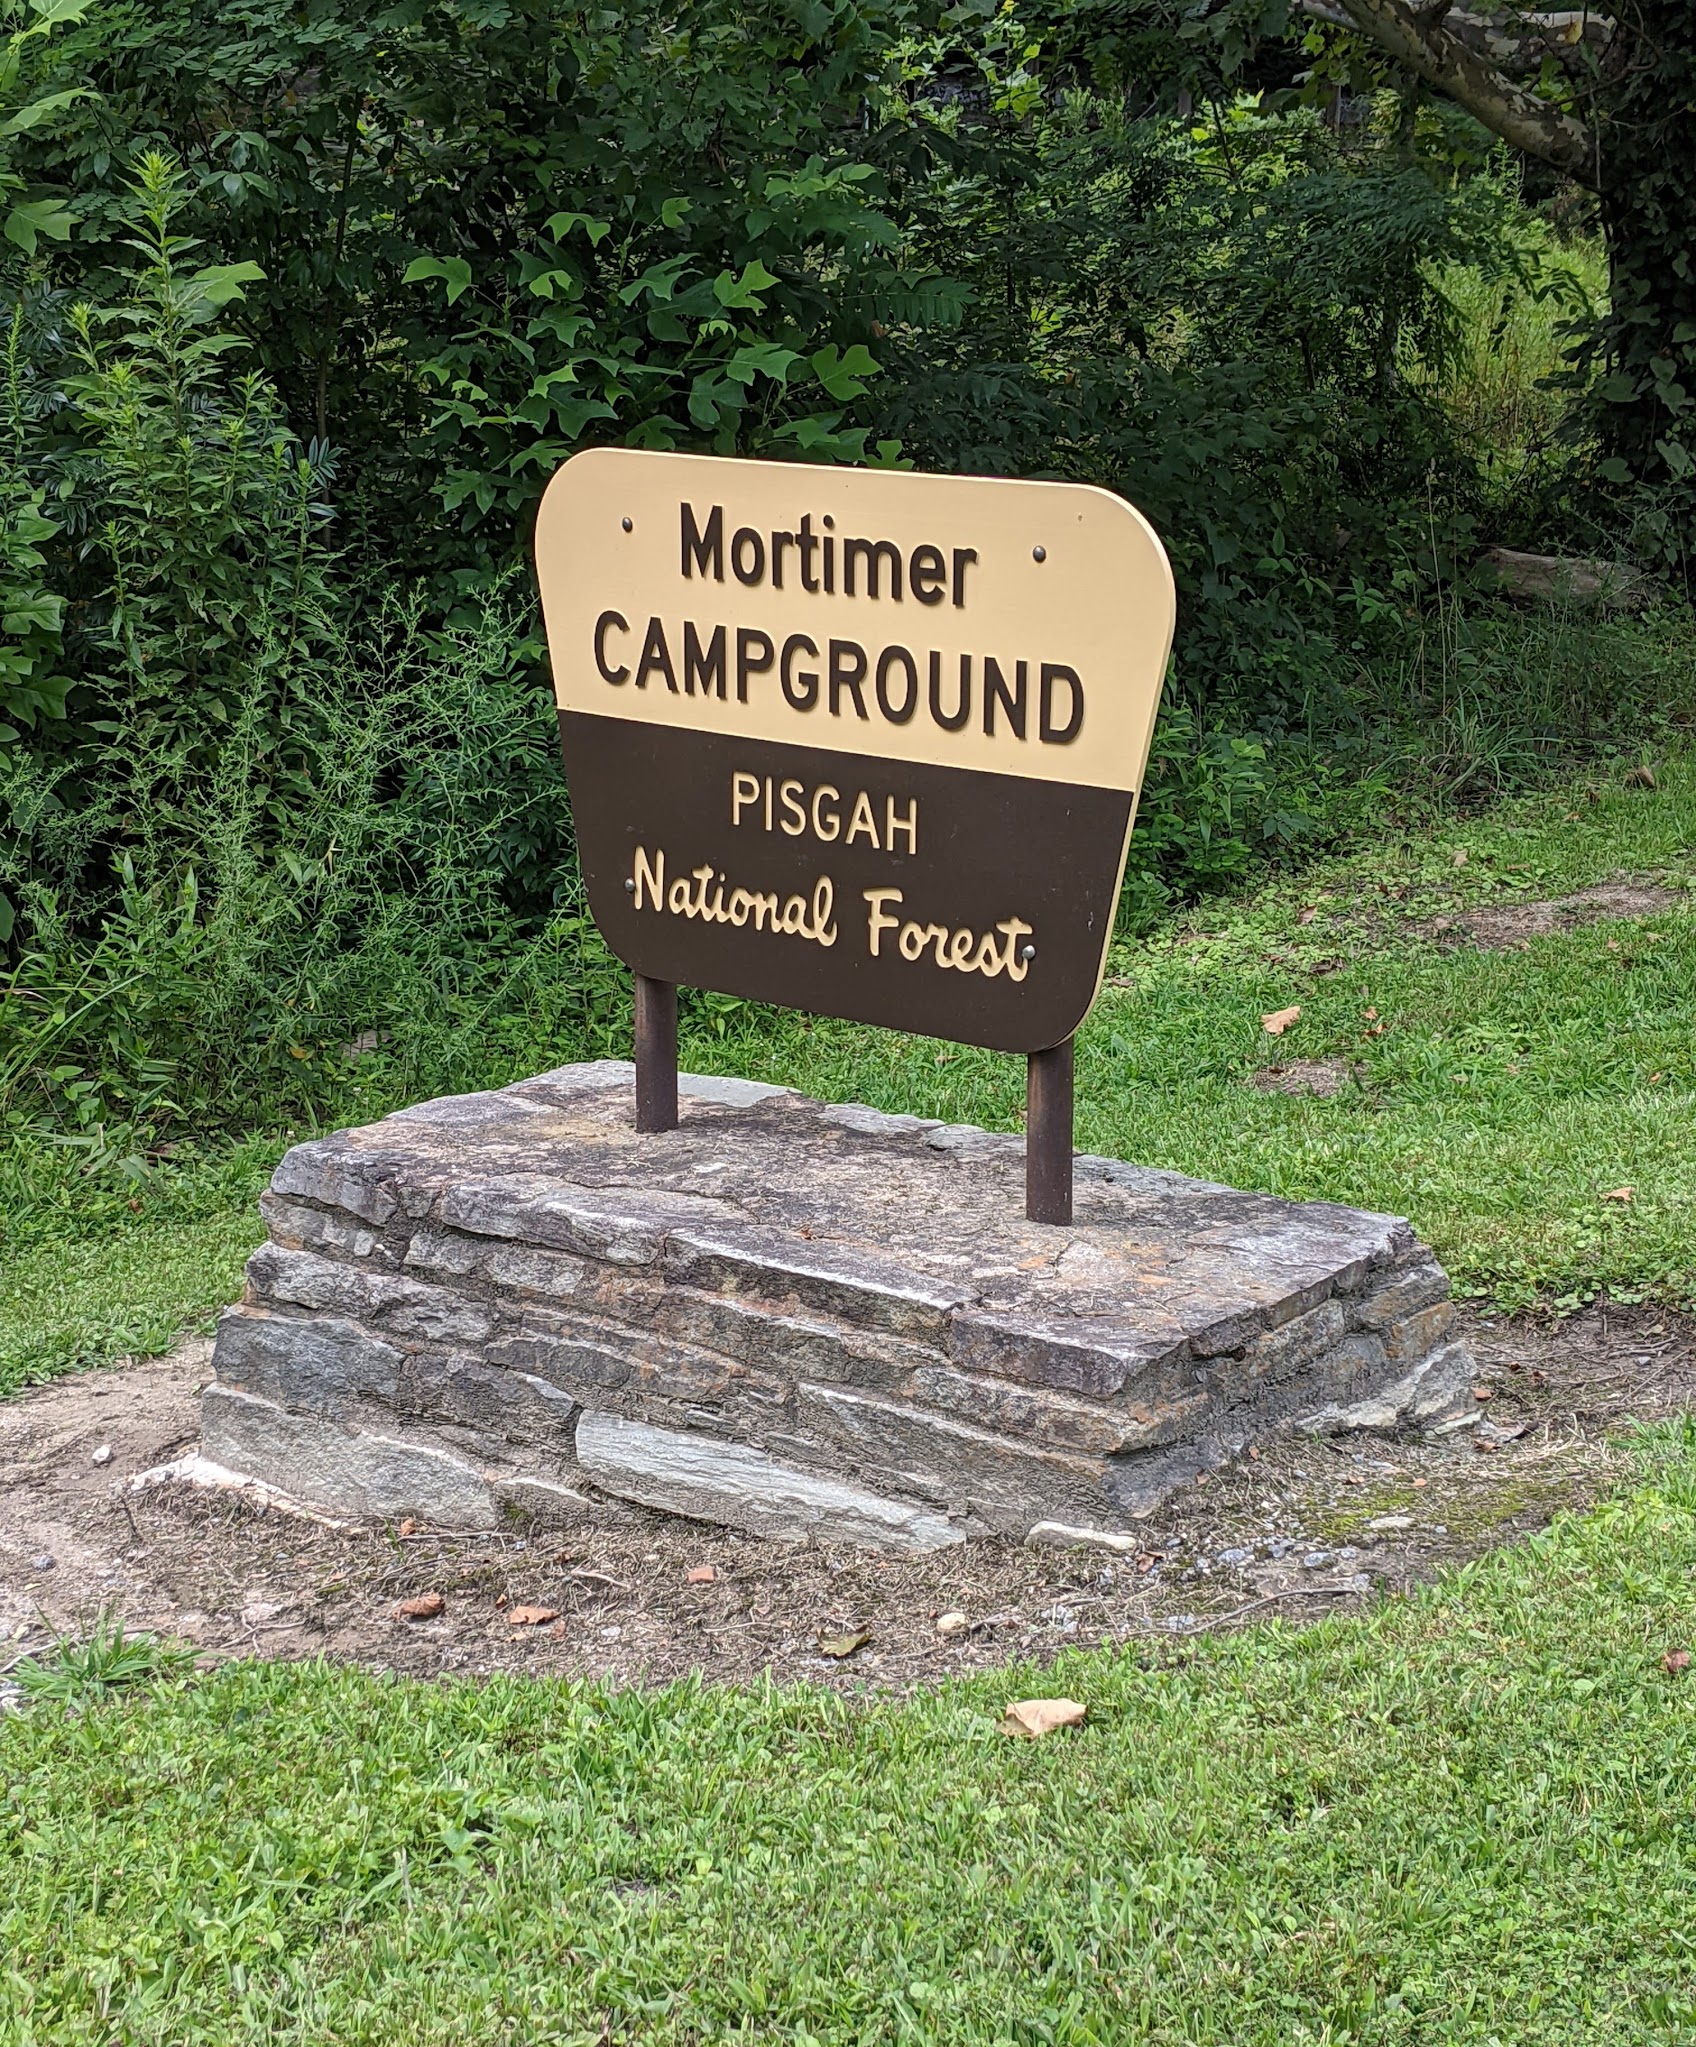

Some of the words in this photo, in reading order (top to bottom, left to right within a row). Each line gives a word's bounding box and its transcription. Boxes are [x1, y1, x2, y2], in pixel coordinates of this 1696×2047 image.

[680, 502, 977, 609] Mortimer
[593, 610, 1085, 746] CAMPGROUND
[731, 771, 919, 855] PISGAH
[632, 847, 838, 947] National
[863, 888, 1034, 983] Forest
